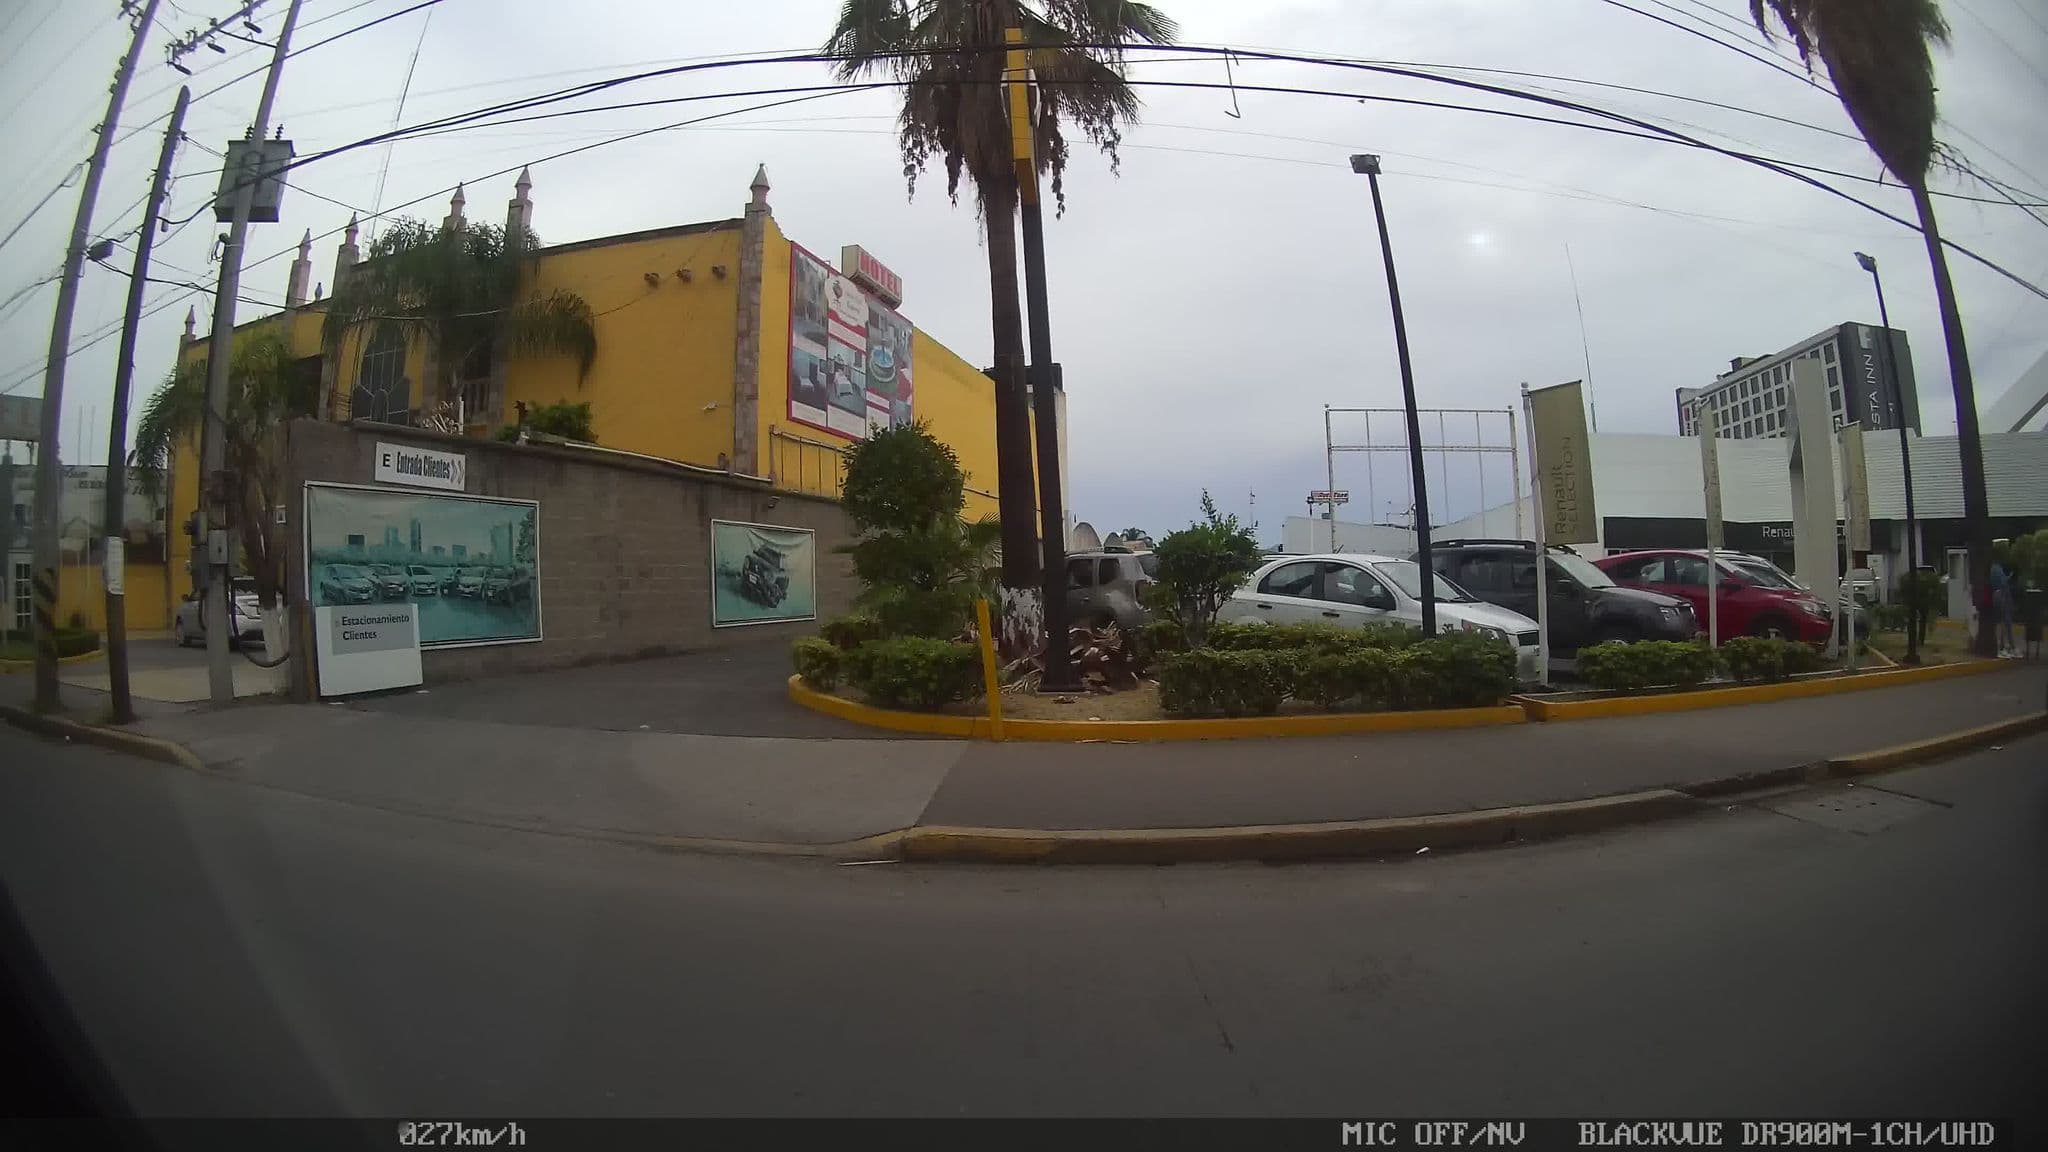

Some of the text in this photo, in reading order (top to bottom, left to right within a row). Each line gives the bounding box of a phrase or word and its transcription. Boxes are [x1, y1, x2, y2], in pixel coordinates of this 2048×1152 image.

[1863, 354, 1877, 384] INN
[383, 451, 450, 480] E Entrada Clientes
[1551, 463, 1567, 535] Renault
[1562, 436, 1578, 535] SELECTION
[341, 614, 410, 626] Estacionamiento
[342, 631, 378, 641] Clientes
